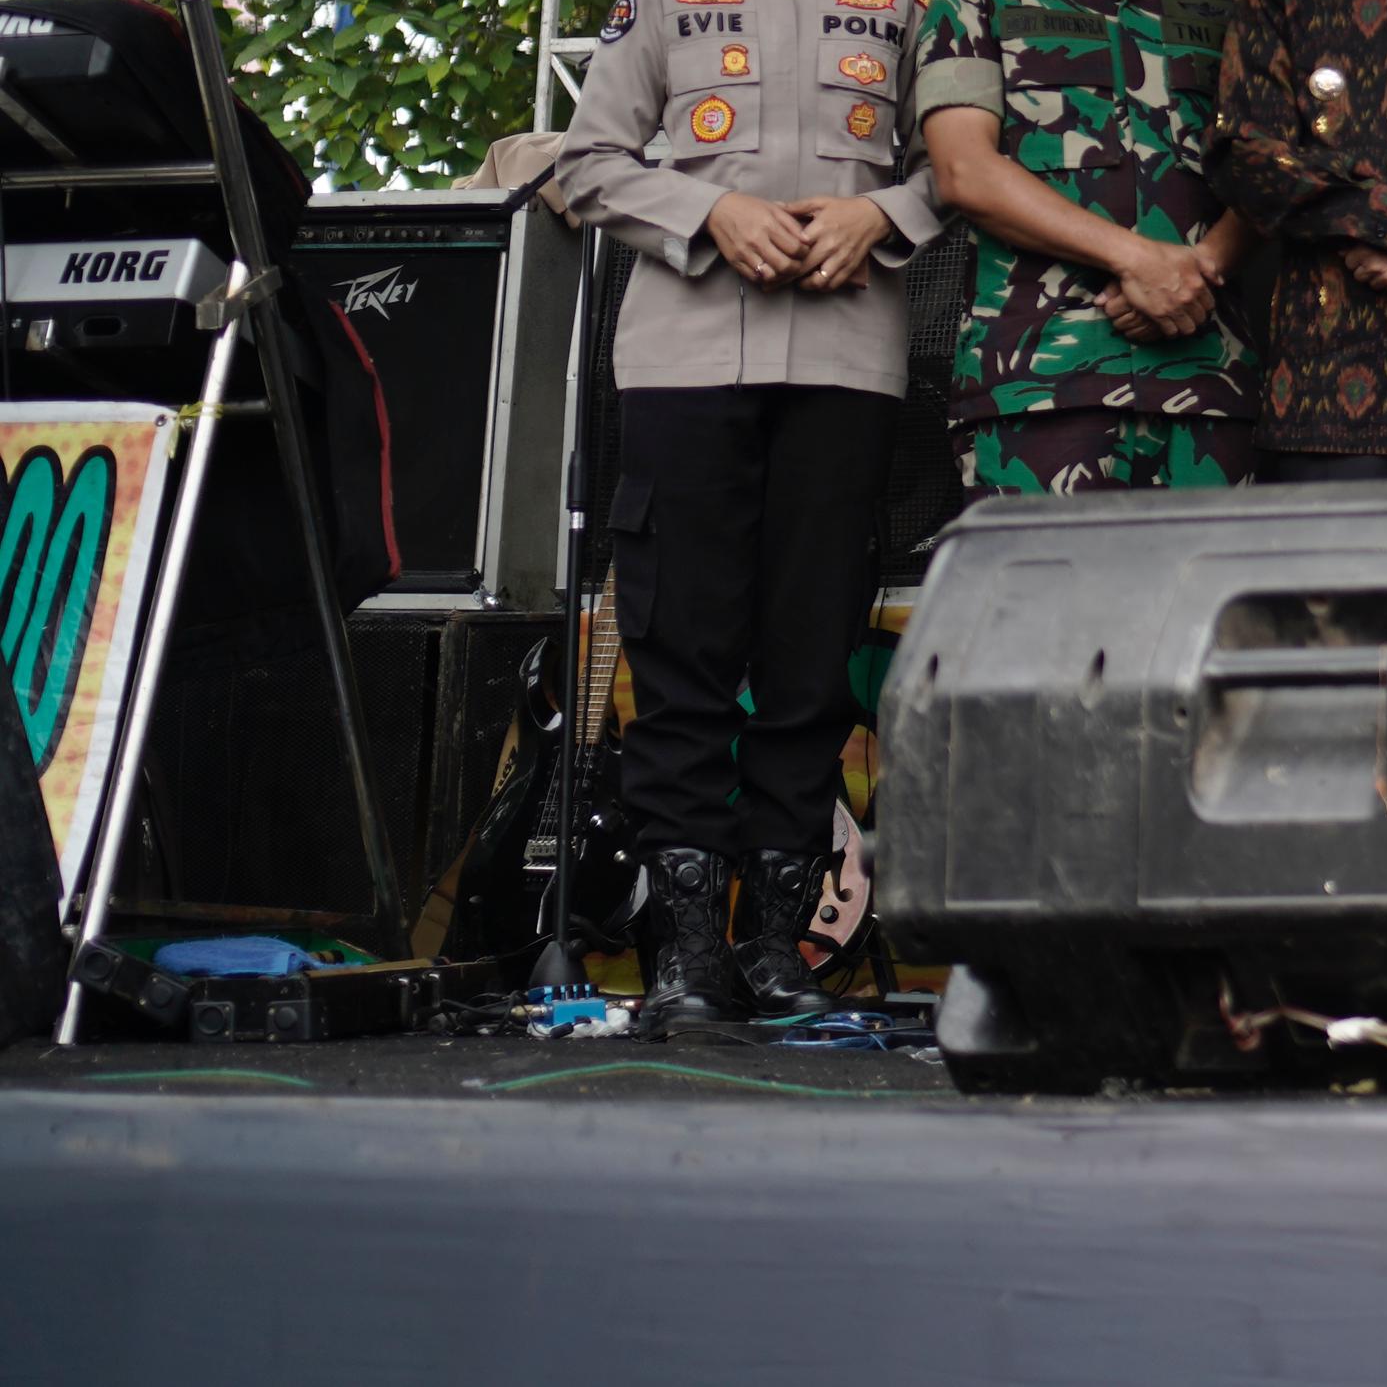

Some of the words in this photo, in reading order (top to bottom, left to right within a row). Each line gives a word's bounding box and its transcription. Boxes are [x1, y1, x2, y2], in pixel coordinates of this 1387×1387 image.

[677, 12, 743, 37] EVIE
[1172, 22, 1211, 43] TNI
[59, 249, 170, 284] KORG
